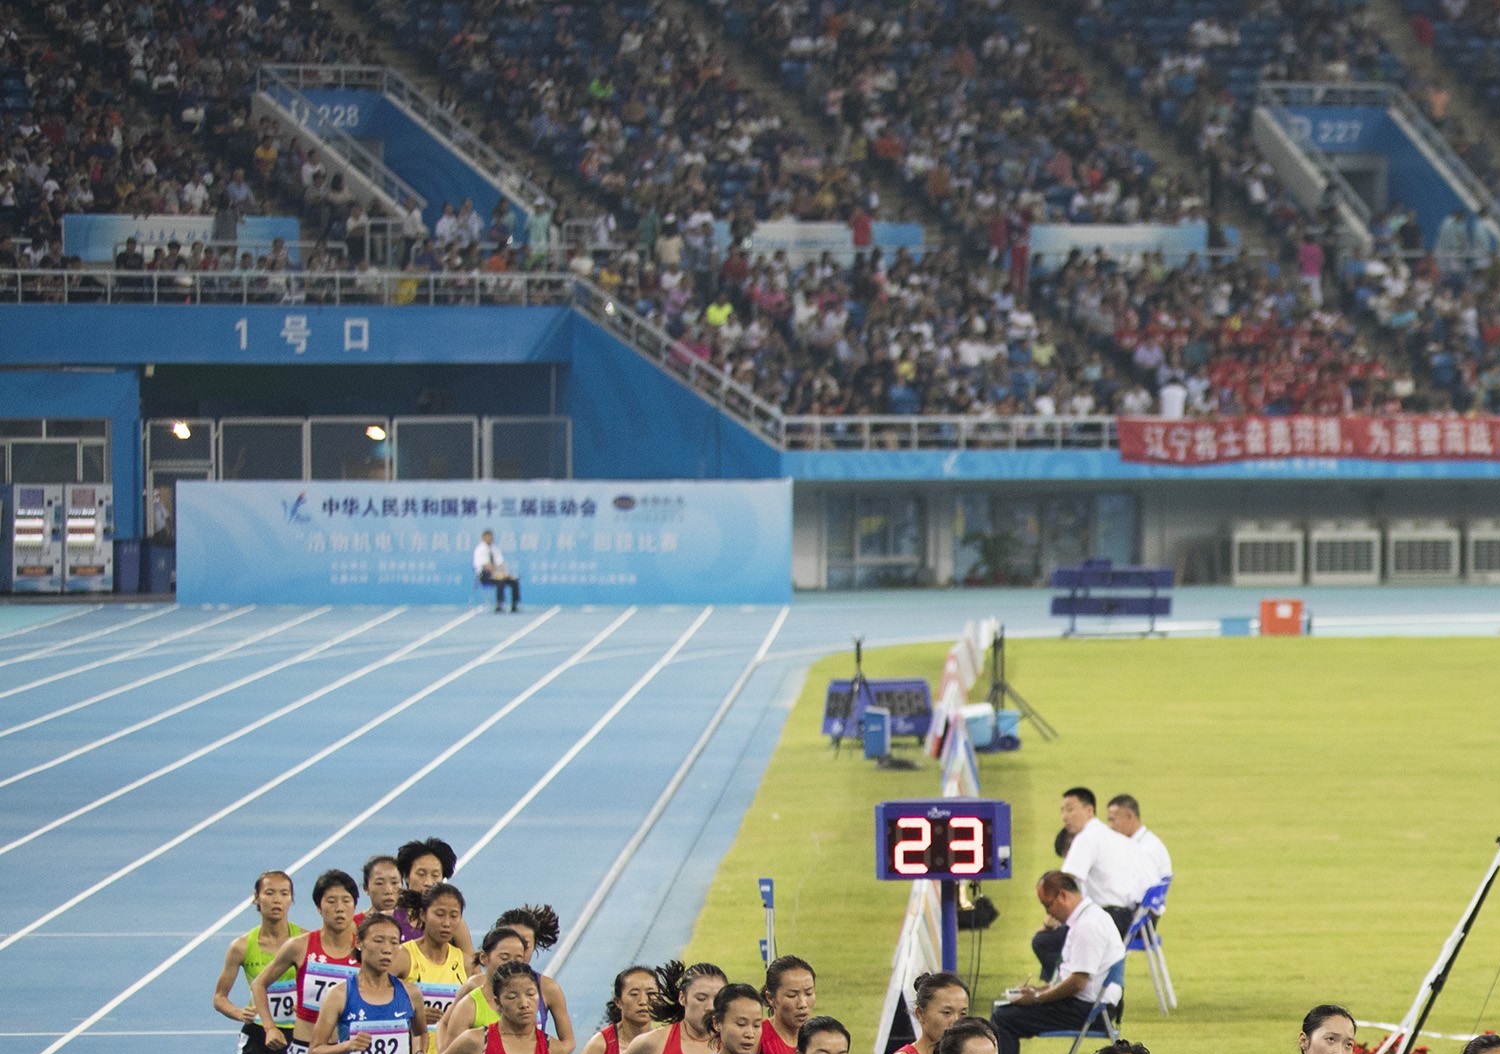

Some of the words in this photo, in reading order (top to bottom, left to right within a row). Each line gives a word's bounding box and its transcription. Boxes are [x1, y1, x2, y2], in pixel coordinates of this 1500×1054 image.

[318, 104, 359, 128] 228
[1319, 120, 1362, 142] 227
[322, 497, 598, 519] 中华人民共和国第十三届运动会
[894, 816, 985, 876] 23
